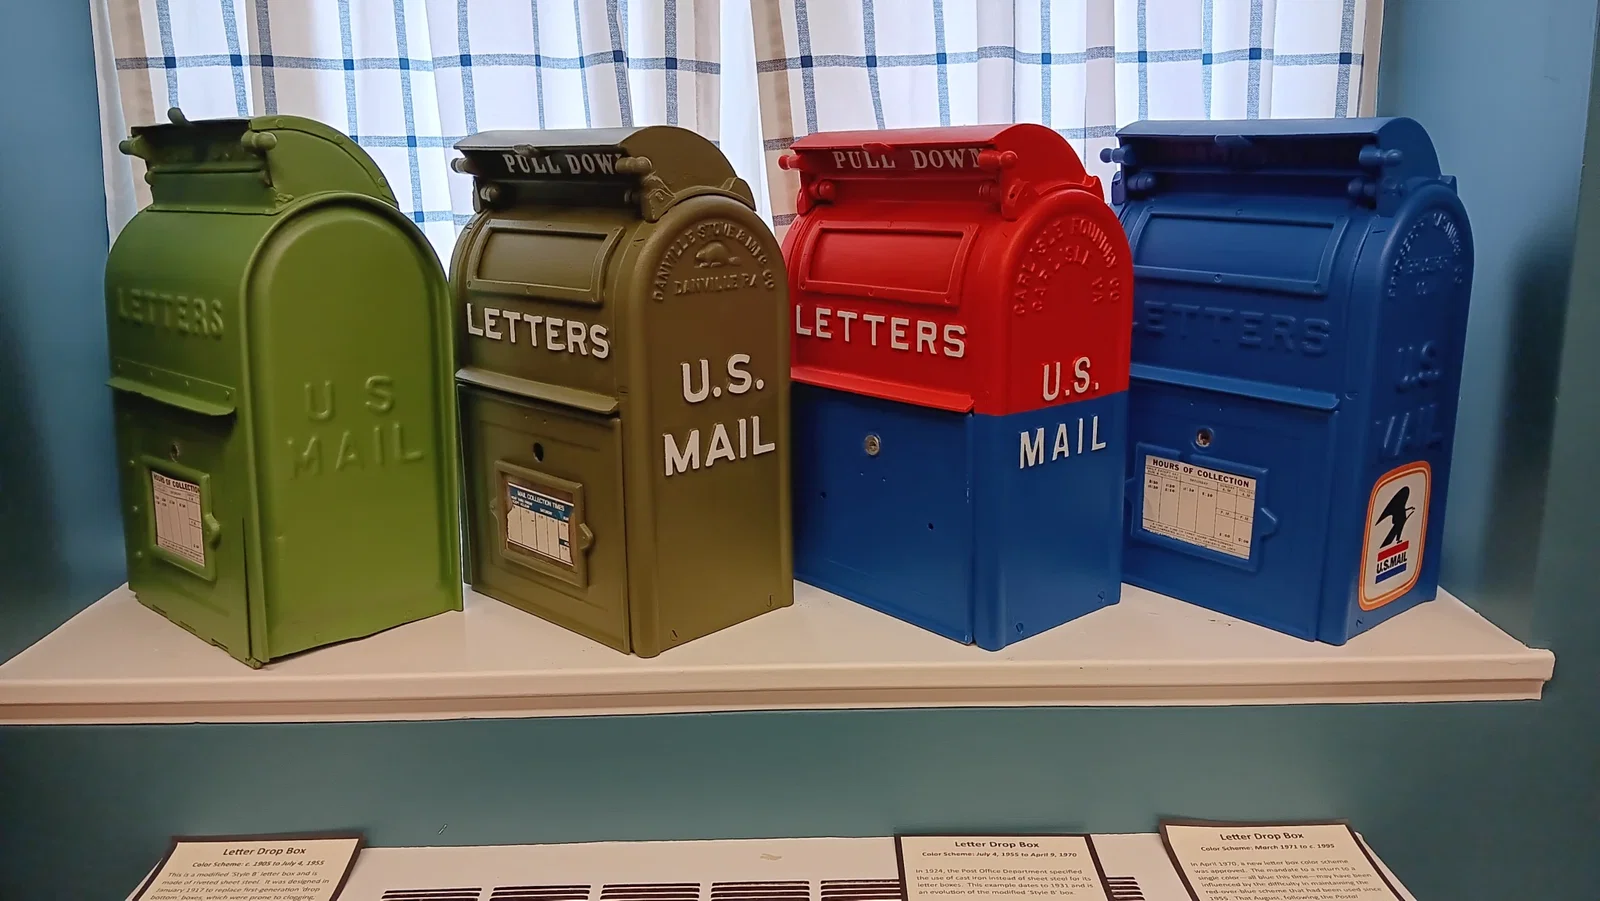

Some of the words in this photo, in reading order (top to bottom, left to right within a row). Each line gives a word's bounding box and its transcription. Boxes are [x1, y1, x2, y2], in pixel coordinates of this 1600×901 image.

[502, 153, 562, 175] PULL
[565, 152, 621, 175] DOW
[833, 151, 896, 170] PULL
[652, 229, 695, 300] DANVILLE
[118, 287, 225, 338] LETTERS
[466, 302, 611, 359] LETTERS
[795, 304, 966, 358] LETTERS
[304, 379, 334, 421] U
[364, 375, 394, 412] S
[681, 353, 764, 404] U.S.
[1042, 356, 1099, 401] U.S.
[286, 422, 425, 478] MAIL
[663, 415, 775, 476] MAIL
[1019, 415, 1106, 469] MAIL
[1152, 459, 1180, 471] HOURS
[1183, 466, 1194, 475] OF
[1197, 470, 1250, 488] COLLECTION
[517, 490, 527, 498] MAIL
[527, 493, 552, 507] COLLECTION
[552, 502, 565, 511] TIMES
[223, 848, 254, 856] Letter
[257, 848, 283, 857] Drop
[990, 841, 1016, 849] Drop
[1220, 833, 1251, 841] Letter
[1254, 833, 1281, 841] Drop
